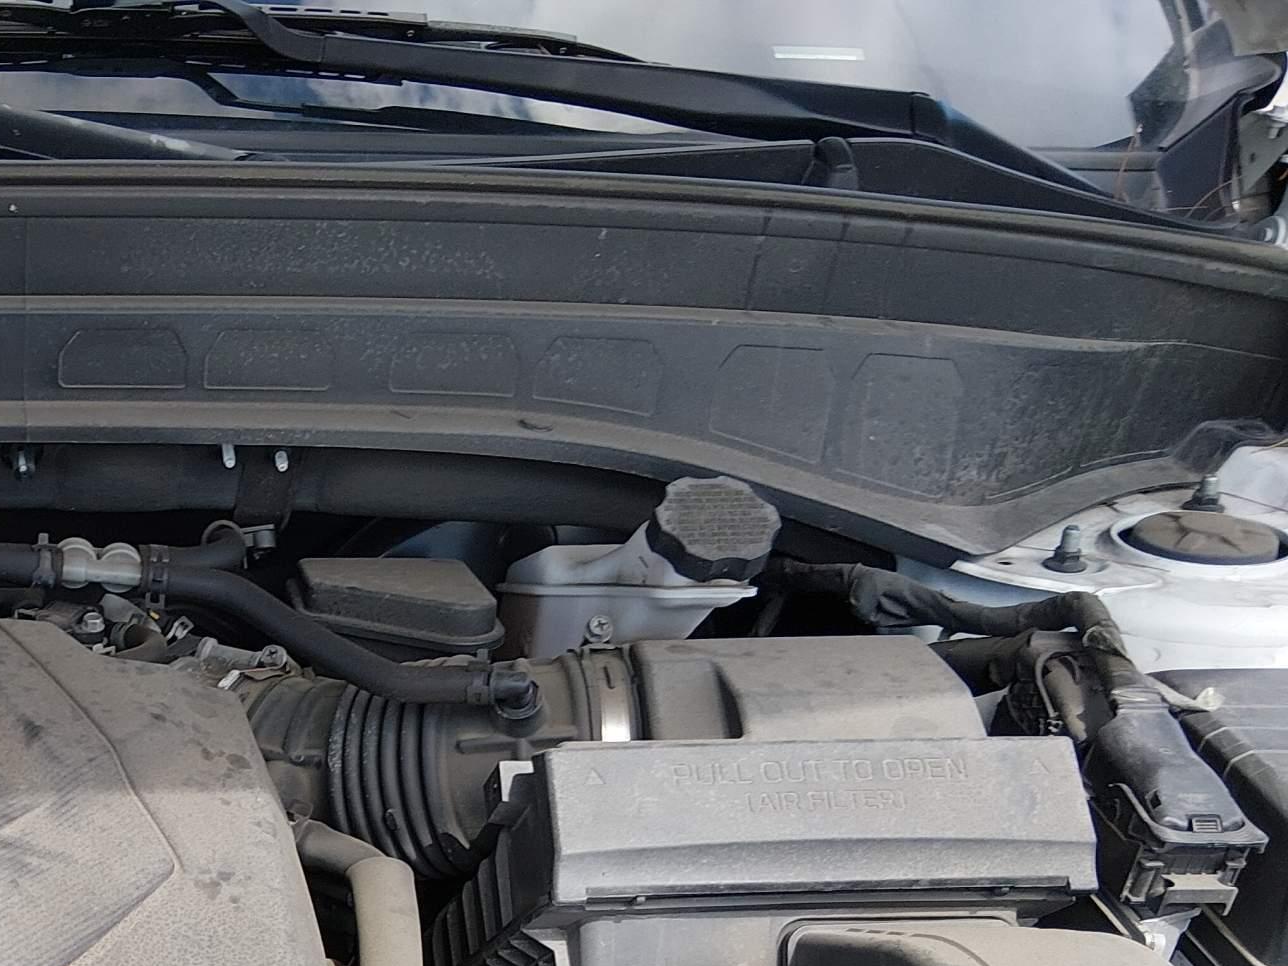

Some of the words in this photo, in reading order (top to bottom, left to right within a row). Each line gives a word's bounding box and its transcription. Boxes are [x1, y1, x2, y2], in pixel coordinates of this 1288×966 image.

[672, 762, 753, 785] PULL
[762, 760, 824, 783] OUT
[832, 759, 873, 781] TO
[882, 757, 969, 780] OPEN
[745, 791, 801, 813] (AIR
[807, 789, 908, 811] FILTER)
